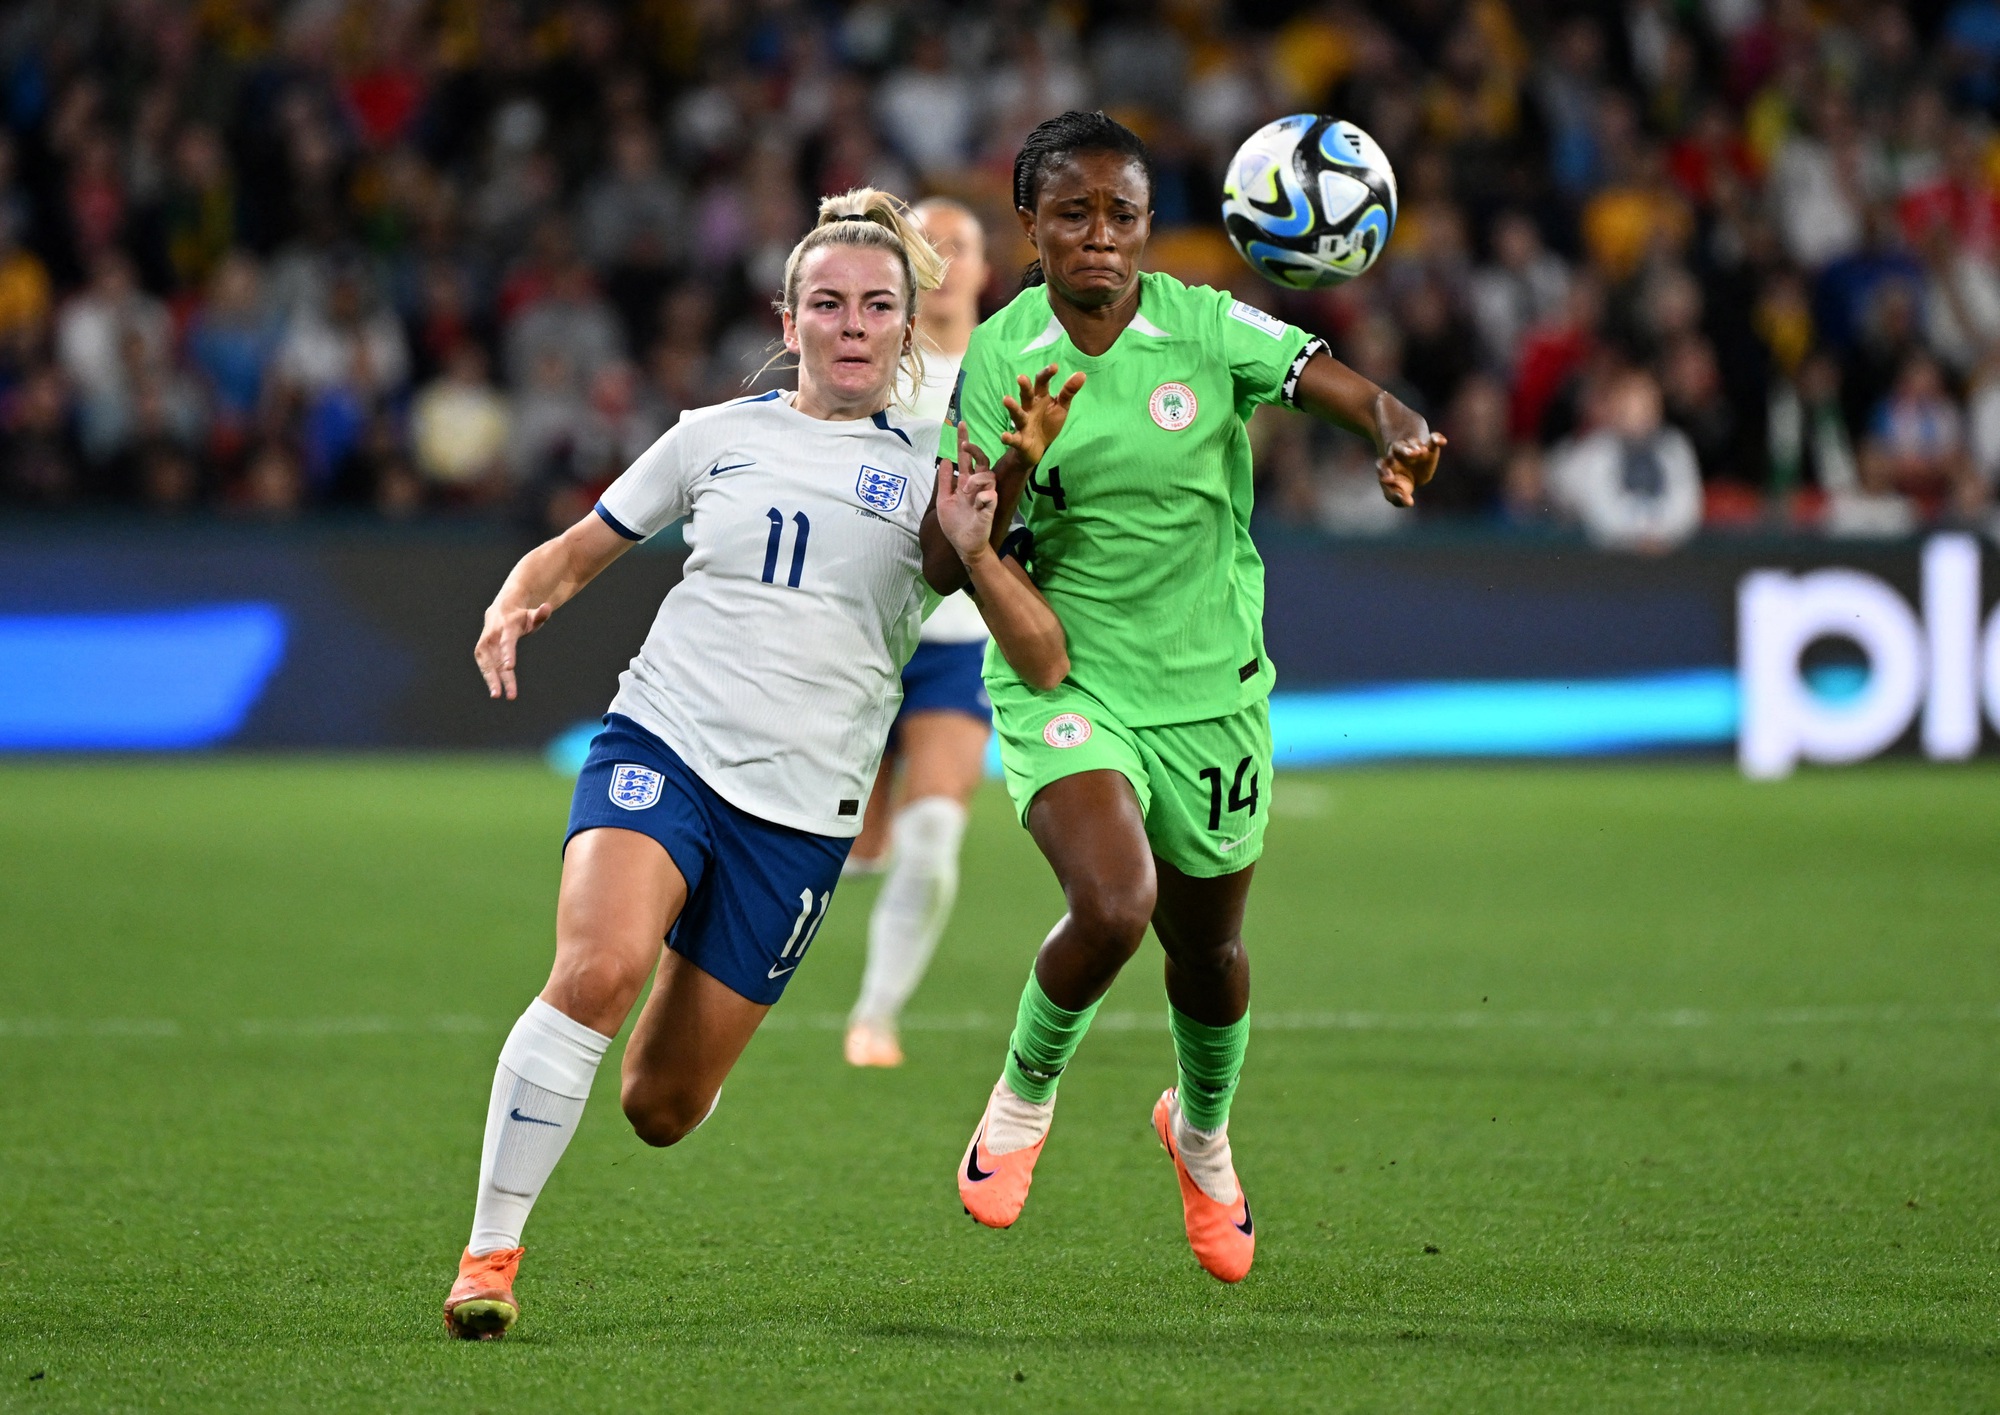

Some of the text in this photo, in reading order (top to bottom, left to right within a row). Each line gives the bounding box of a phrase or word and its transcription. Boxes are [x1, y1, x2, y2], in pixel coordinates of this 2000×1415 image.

[761, 507, 810, 589] 11
[1736, 530, 2000, 782] pl
[1199, 755, 1259, 831] 14
[780, 887, 830, 958] 11
